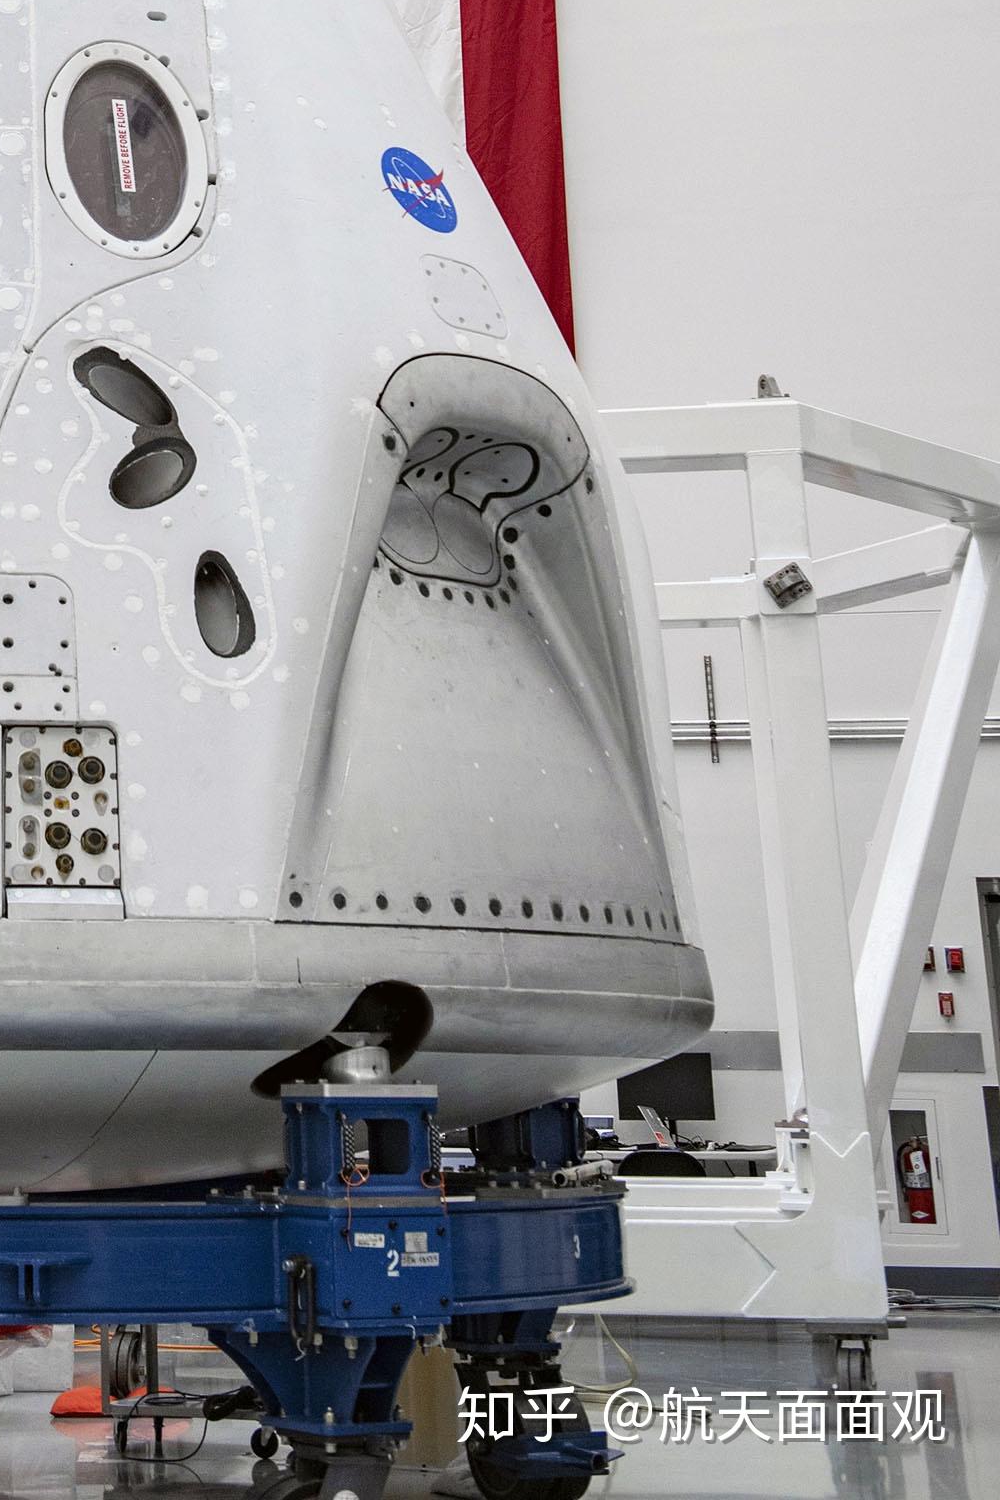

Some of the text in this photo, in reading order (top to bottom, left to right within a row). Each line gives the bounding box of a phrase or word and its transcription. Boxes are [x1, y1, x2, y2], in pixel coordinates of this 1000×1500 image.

[115, 102, 133, 190] REMOVE BEFORE FLIGHT
[387, 173, 452, 208] NASA
[573, 1234, 581, 1259] 3
[386, 1249, 400, 1277] 2
